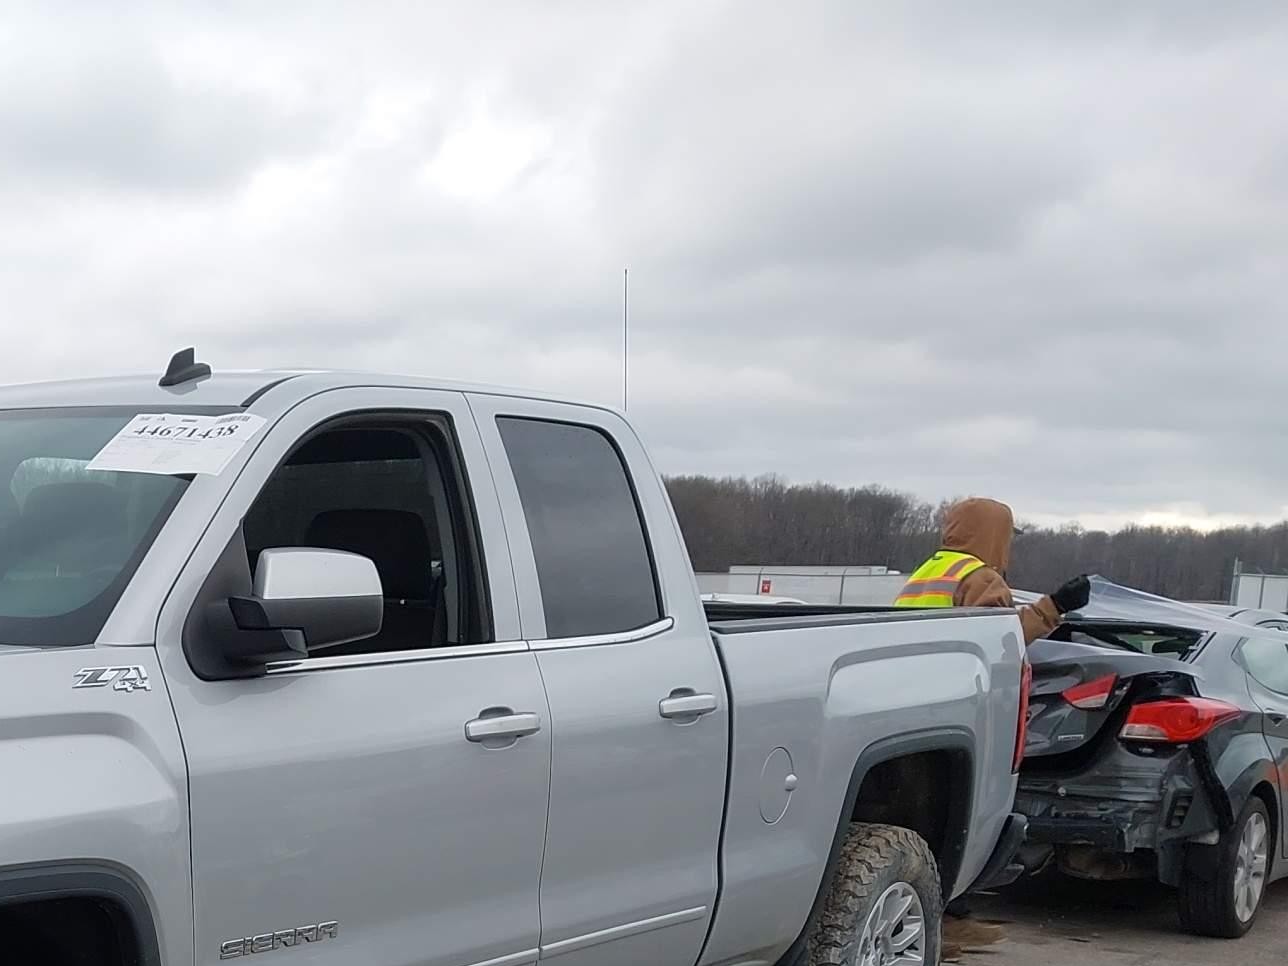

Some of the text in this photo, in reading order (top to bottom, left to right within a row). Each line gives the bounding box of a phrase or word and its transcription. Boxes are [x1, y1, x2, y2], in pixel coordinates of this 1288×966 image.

[134, 424, 239, 439] 44671438
[72, 665, 148, 689] Z71
[220, 920, 339, 960] SIERRA
